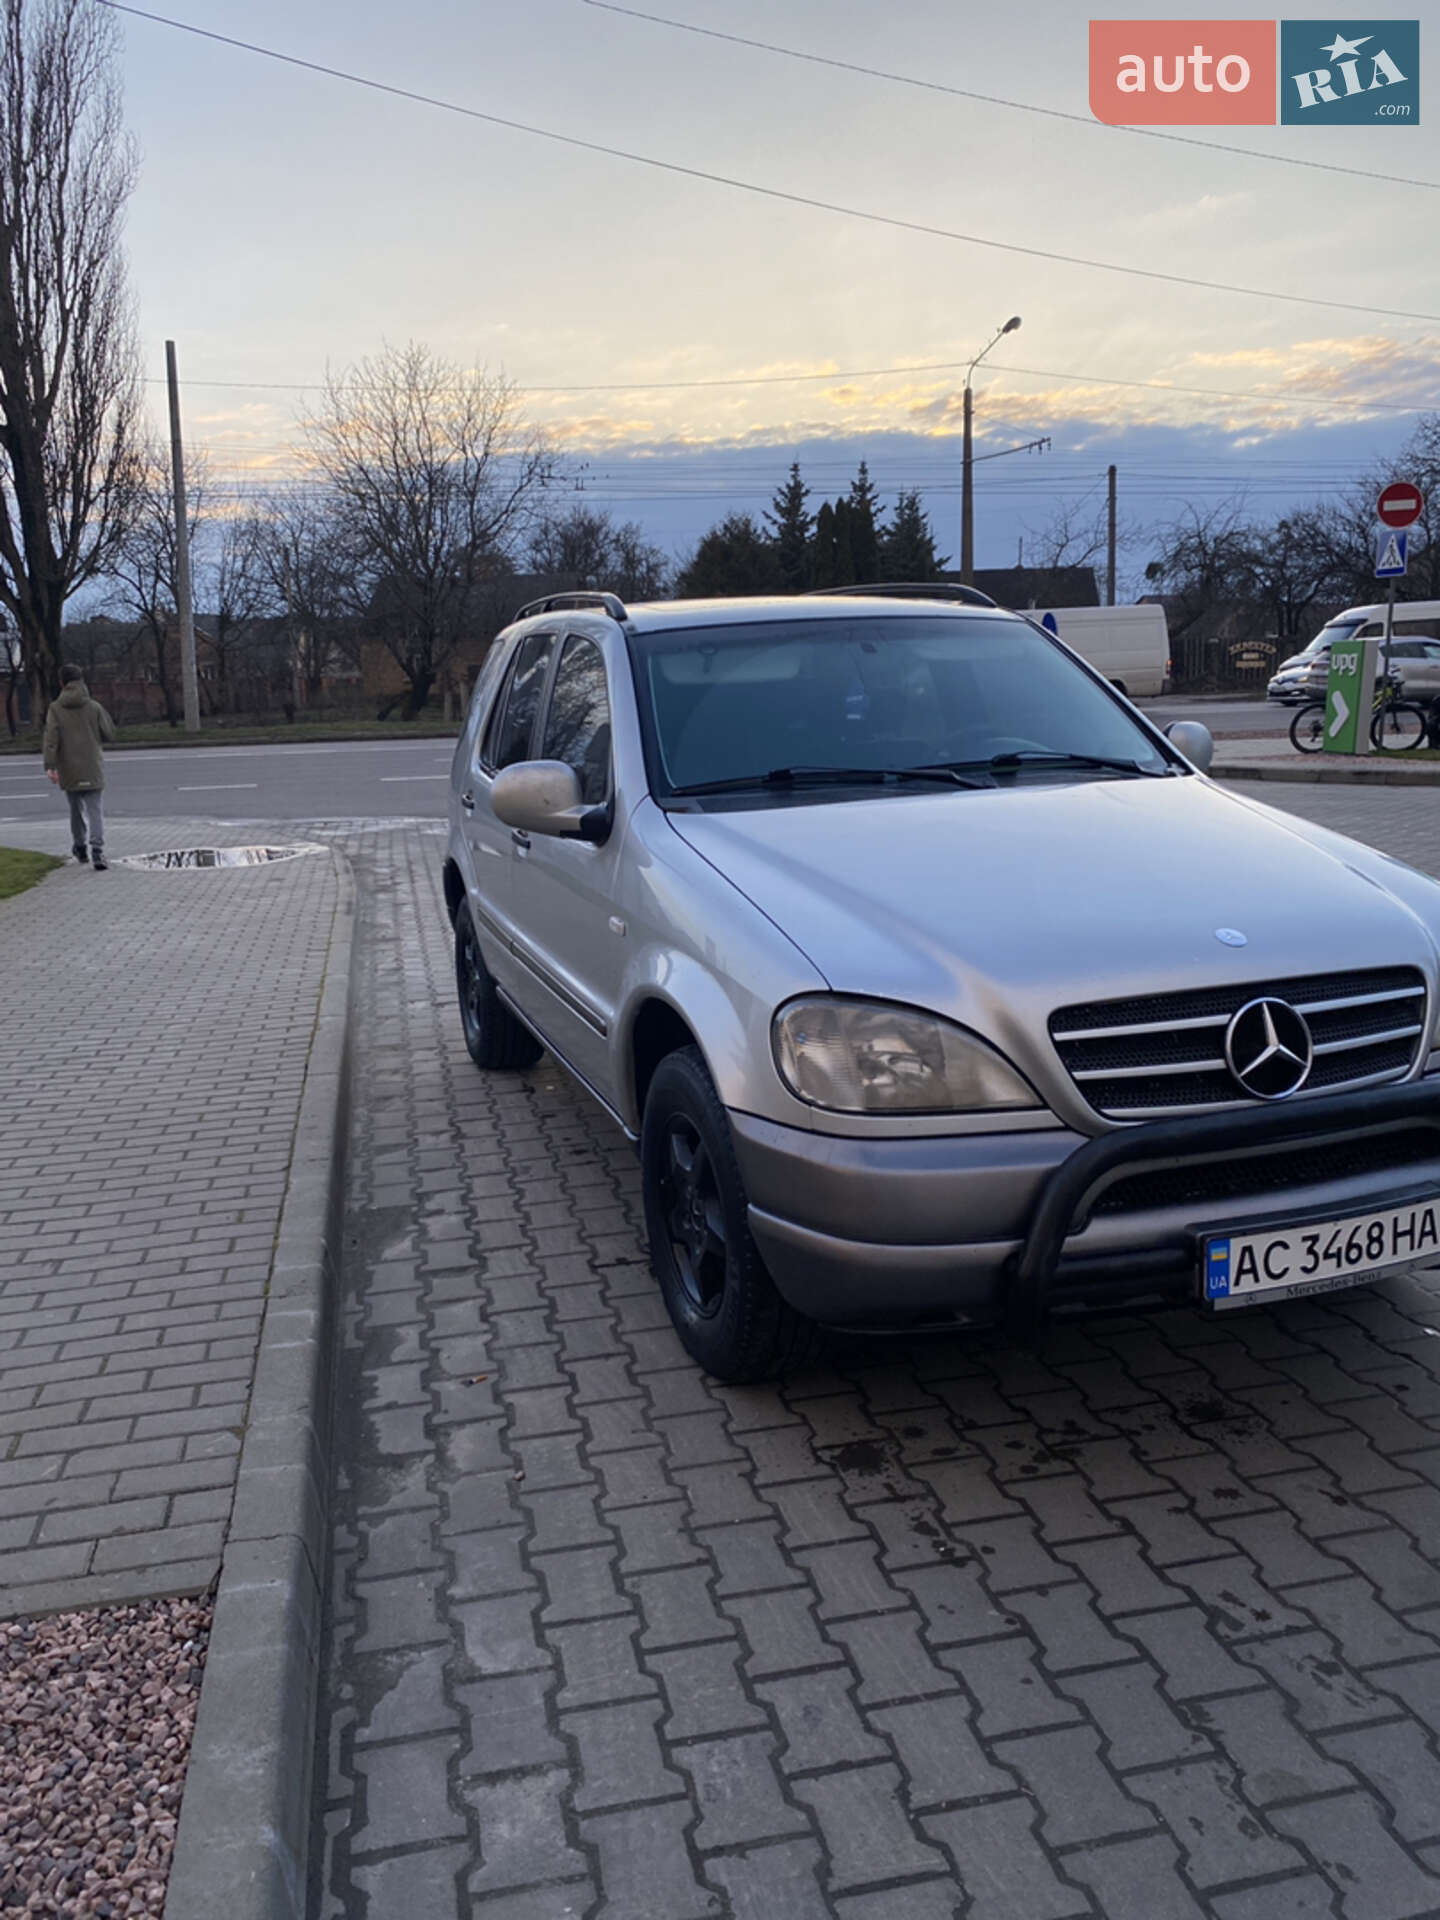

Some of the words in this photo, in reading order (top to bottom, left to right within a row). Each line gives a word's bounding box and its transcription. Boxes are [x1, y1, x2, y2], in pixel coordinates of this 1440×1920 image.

[1332, 653, 1358, 676] upg
[1233, 1240, 1291, 1287] AC
[1300, 1221, 1384, 1274] 3468
[1392, 1208, 1438, 1256] HA
[1210, 1275, 1227, 1289] UA
